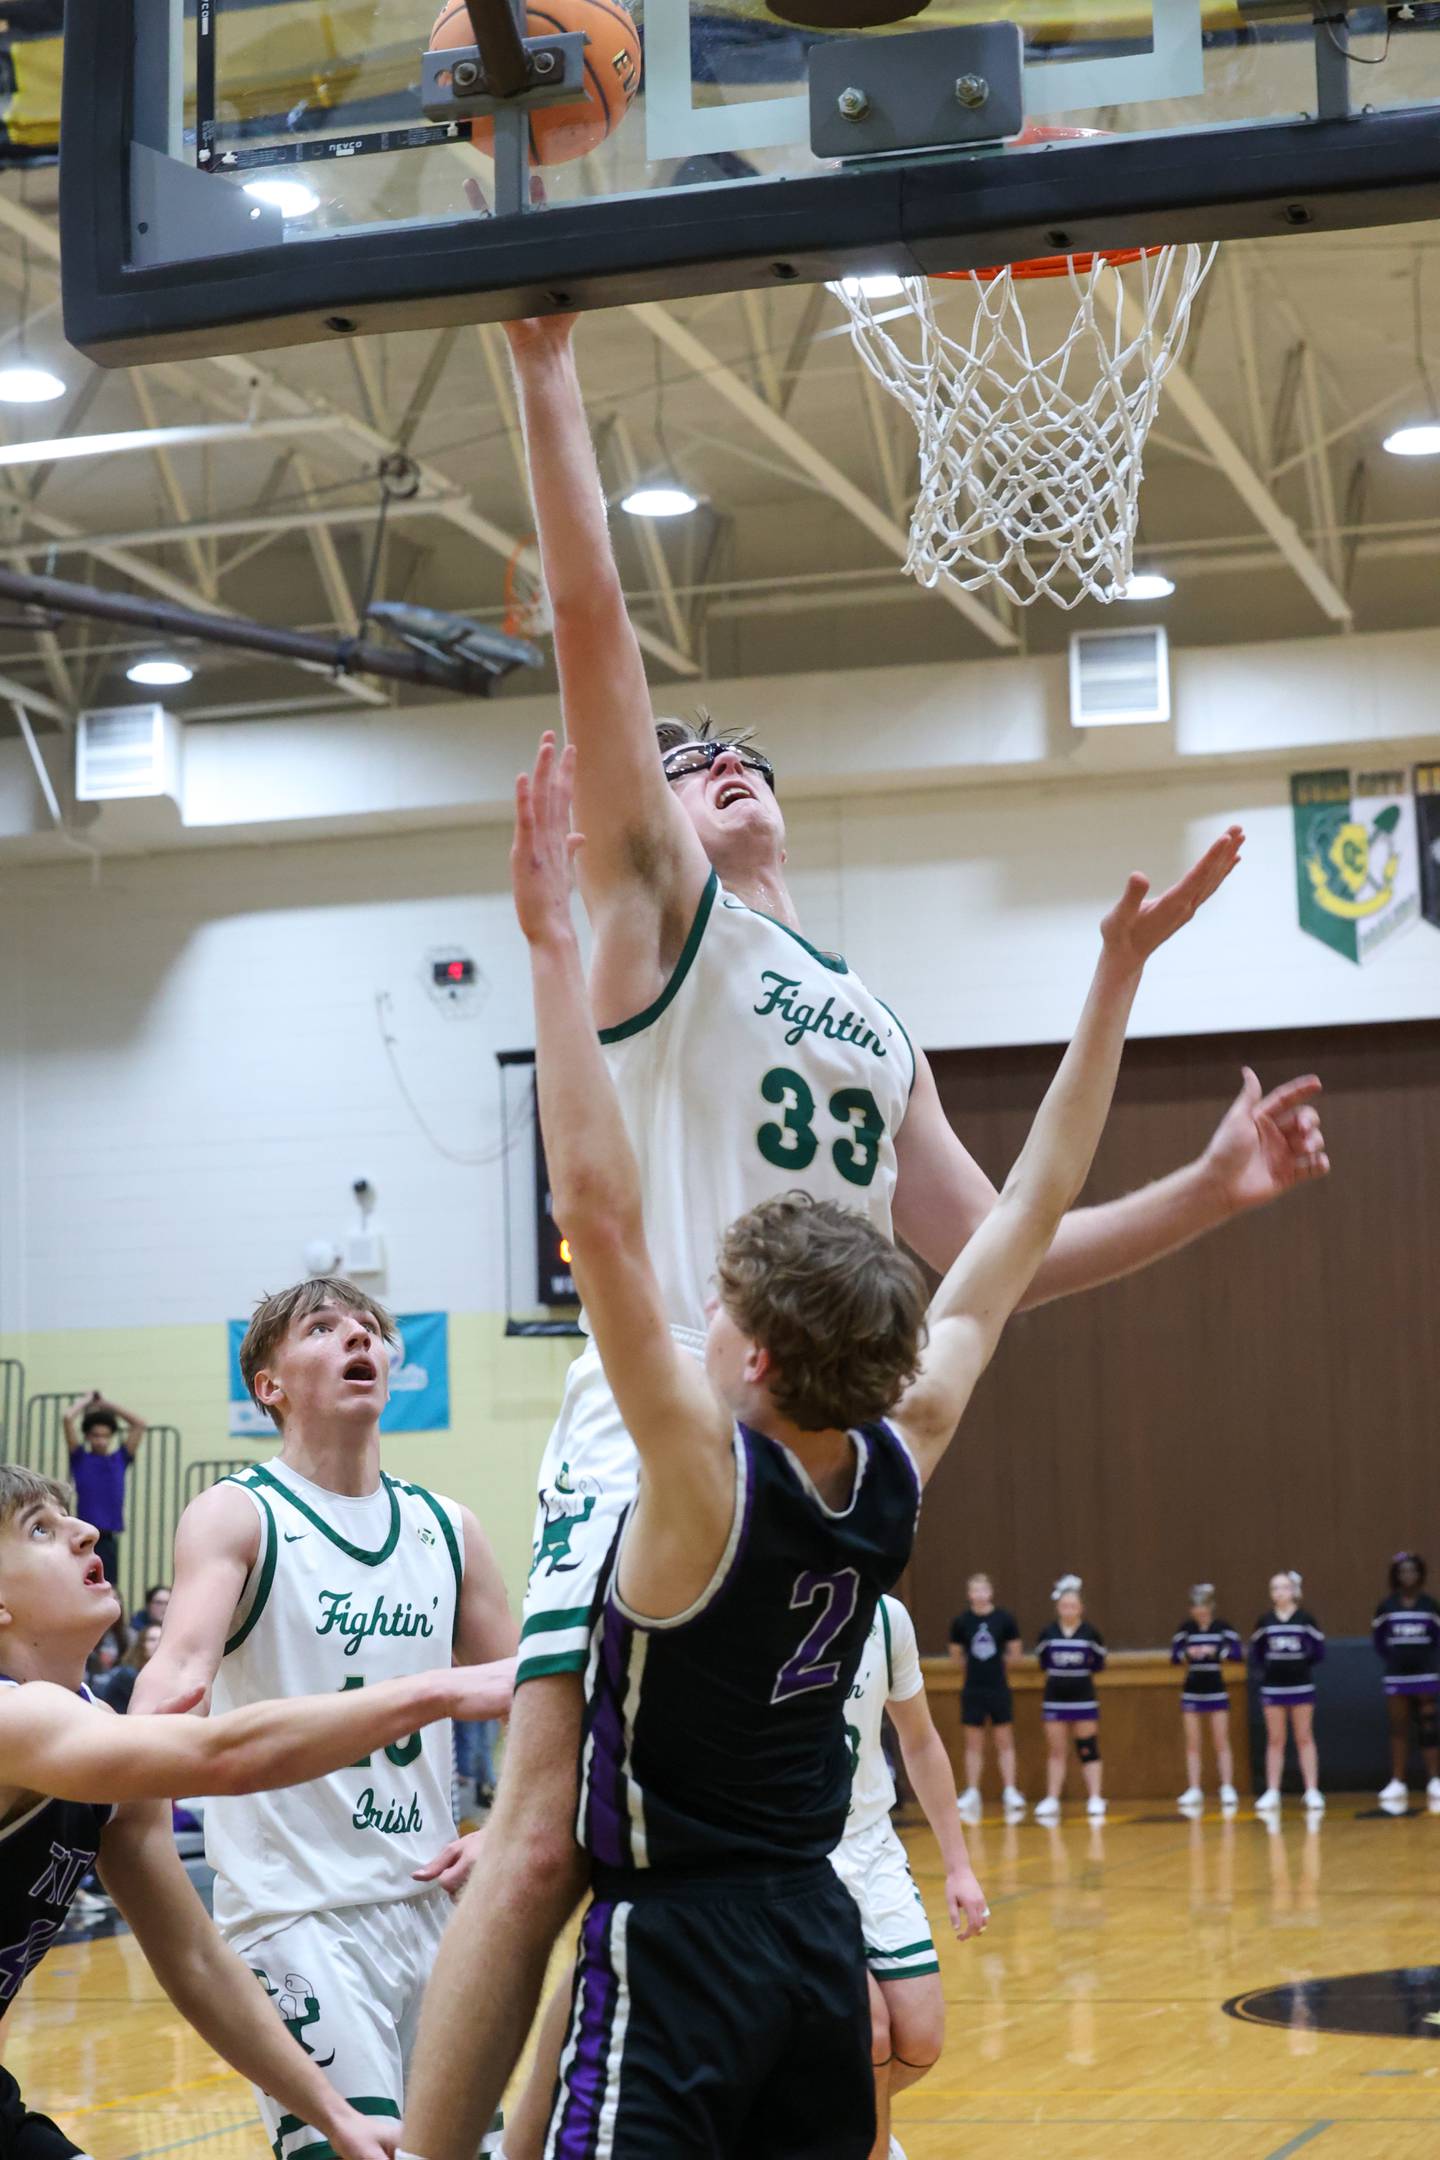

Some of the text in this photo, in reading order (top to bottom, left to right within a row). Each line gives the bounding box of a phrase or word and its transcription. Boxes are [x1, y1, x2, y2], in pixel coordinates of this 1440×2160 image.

[754, 970, 892, 1057] Fightin'
[757, 1067, 886, 1186] 33
[316, 1589, 439, 1656] Fightin'
[770, 1567, 860, 1704] 2
[352, 1787, 423, 1834] Irish
